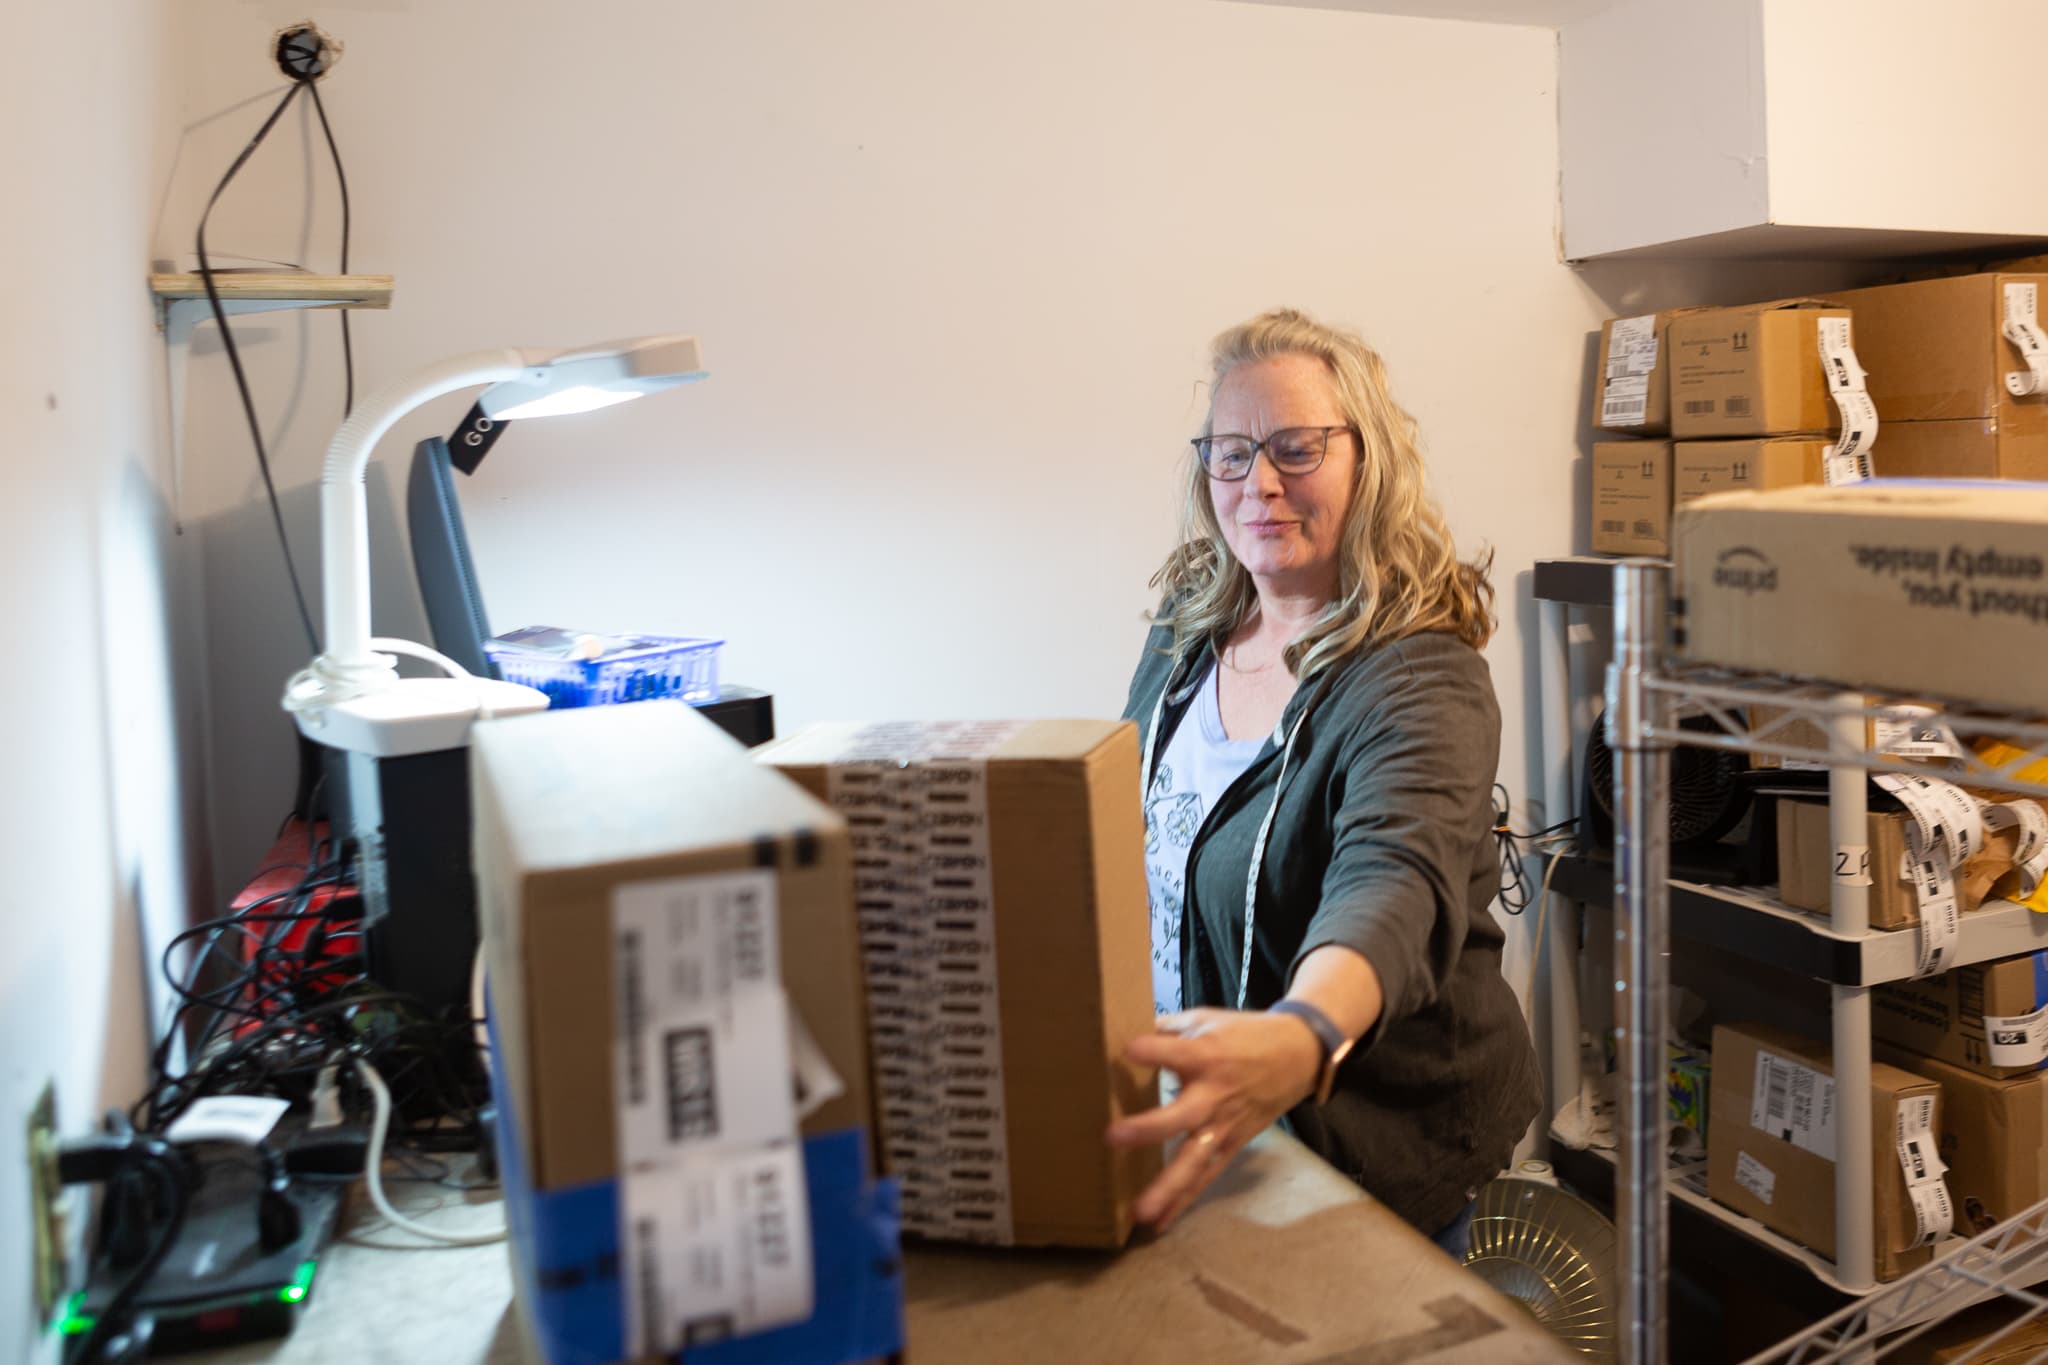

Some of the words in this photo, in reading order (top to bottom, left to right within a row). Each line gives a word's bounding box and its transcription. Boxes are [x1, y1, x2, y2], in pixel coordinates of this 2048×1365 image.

[464, 417, 493, 447] GO
[1848, 543, 1940, 578] inside.
[1944, 545, 2044, 580] empty
[1712, 566, 1779, 597] prime
[1900, 578, 1962, 609] you,
